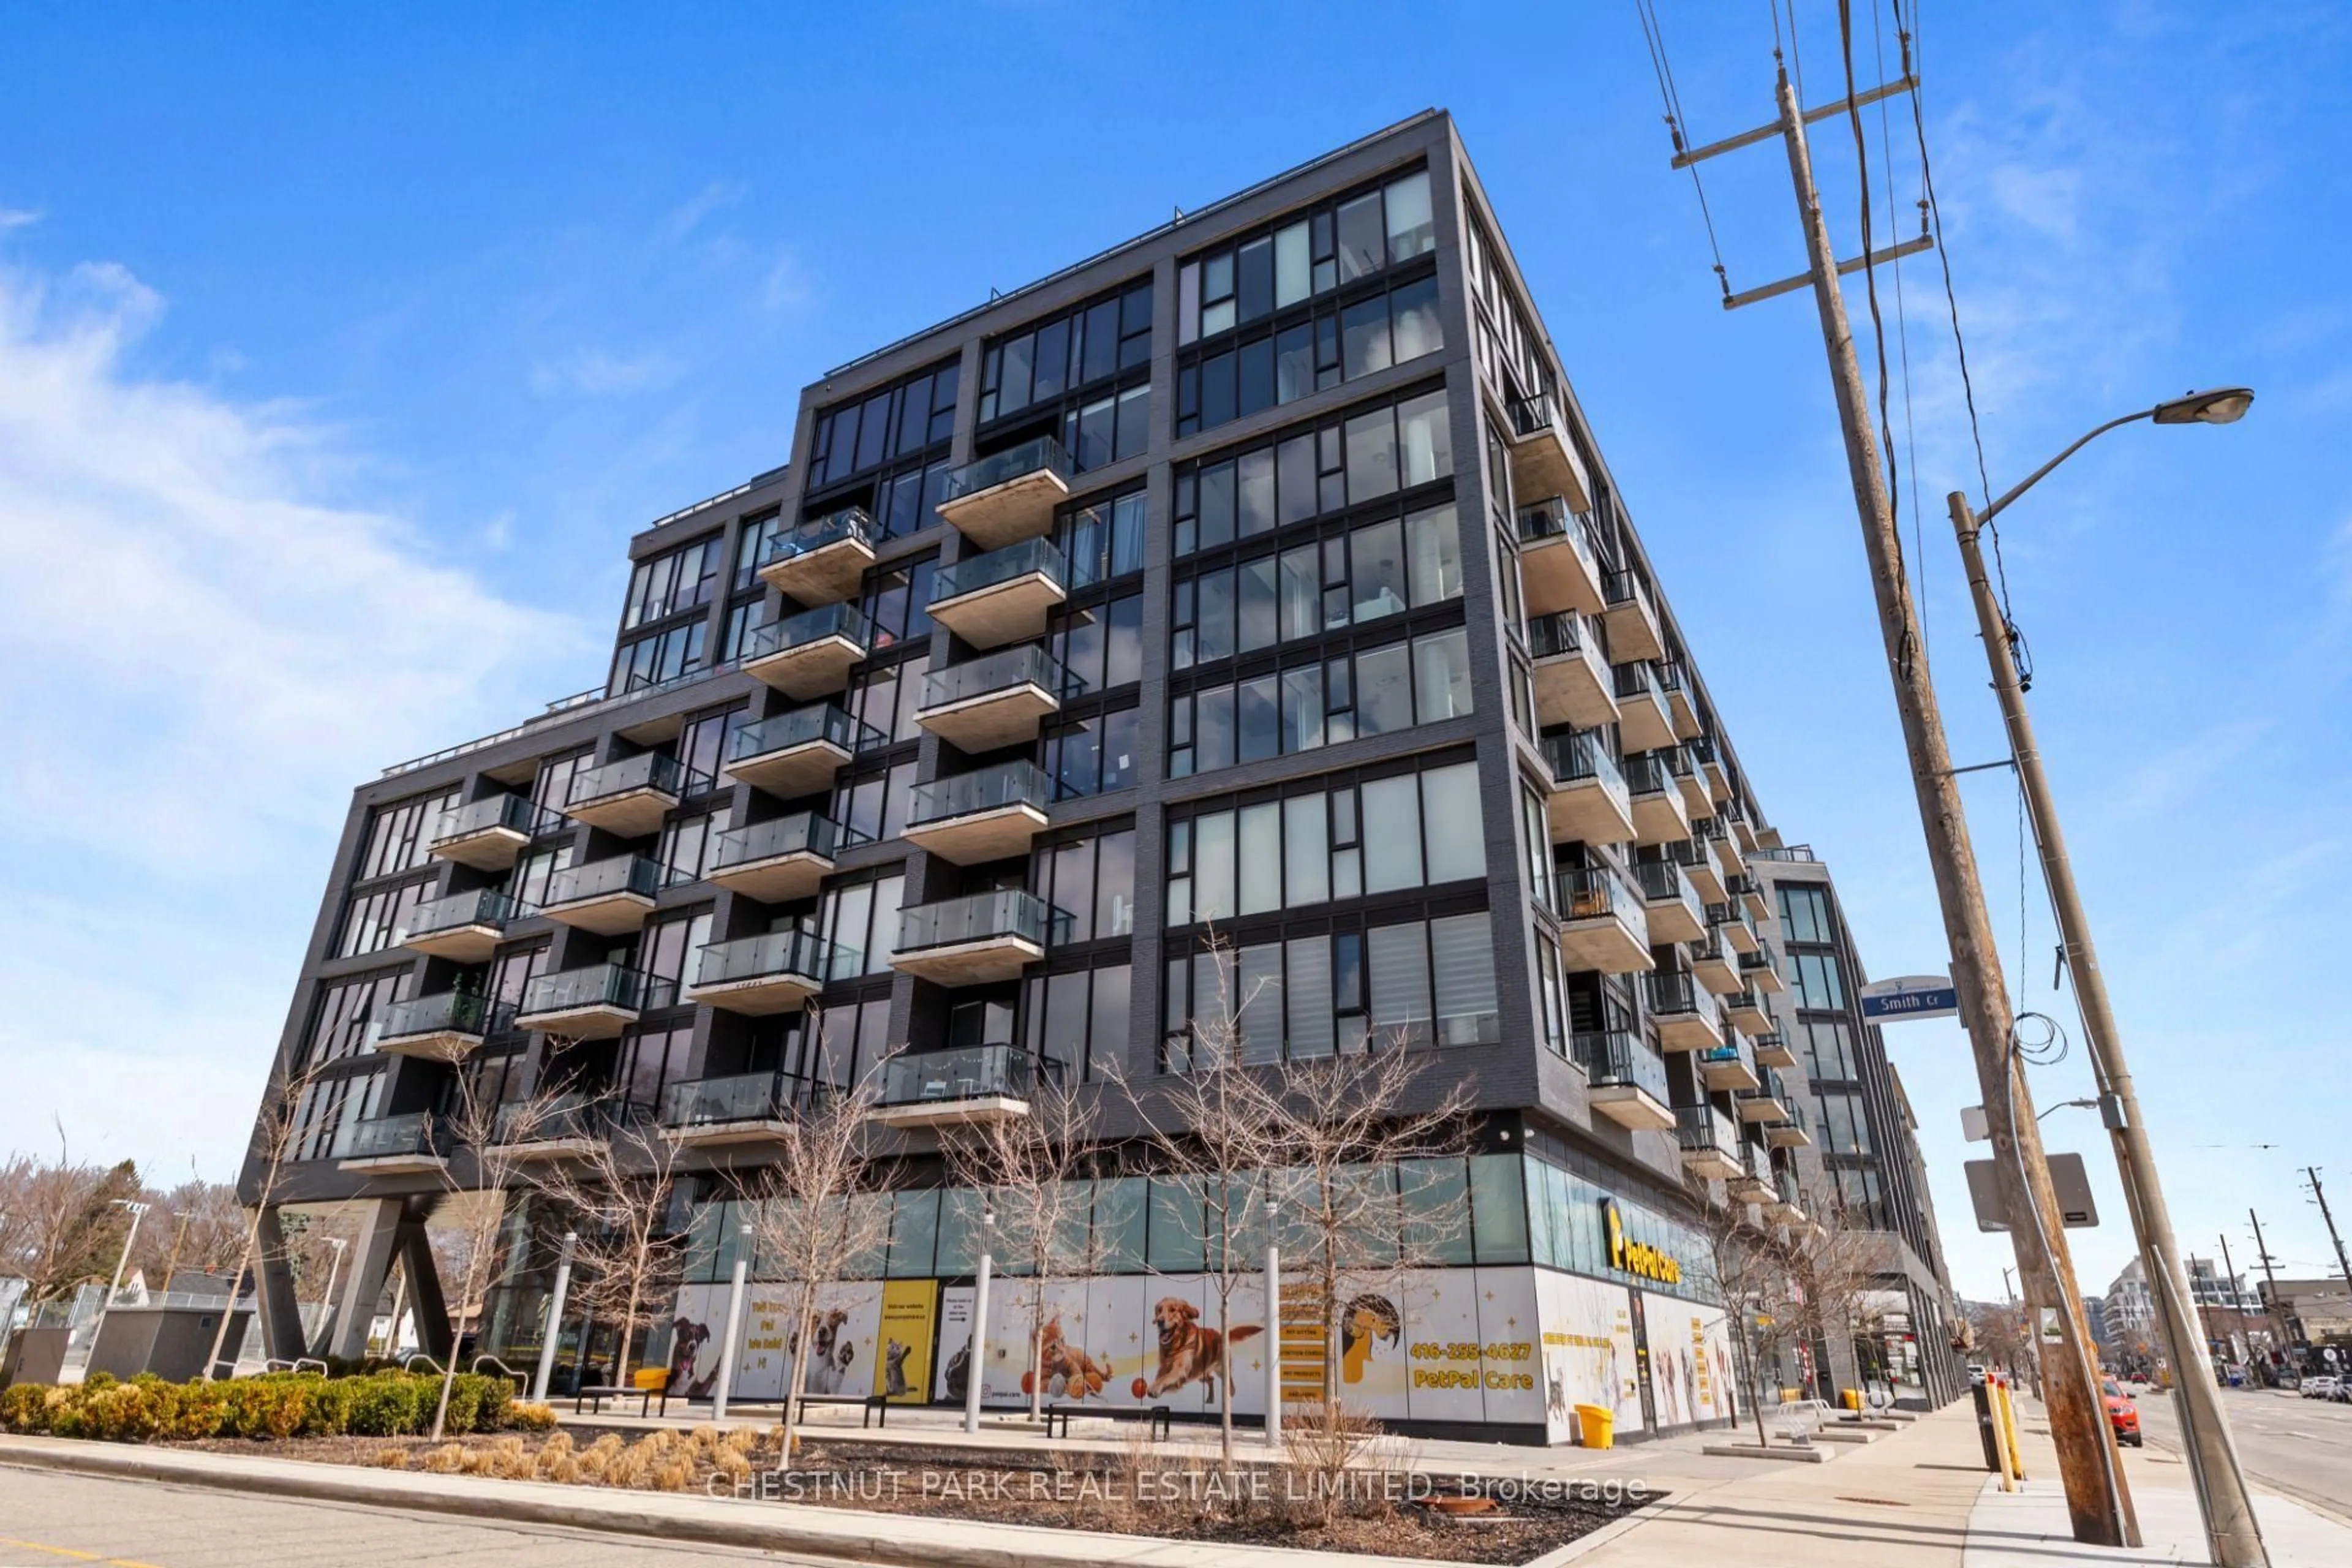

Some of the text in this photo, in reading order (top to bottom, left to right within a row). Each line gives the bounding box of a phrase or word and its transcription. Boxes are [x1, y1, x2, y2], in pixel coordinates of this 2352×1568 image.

[1880, 995, 1939, 1011] Smith Cr
[1624, 1237, 1659, 1279] PetPal
[1414, 1368, 1533, 1390] PetPal Care
